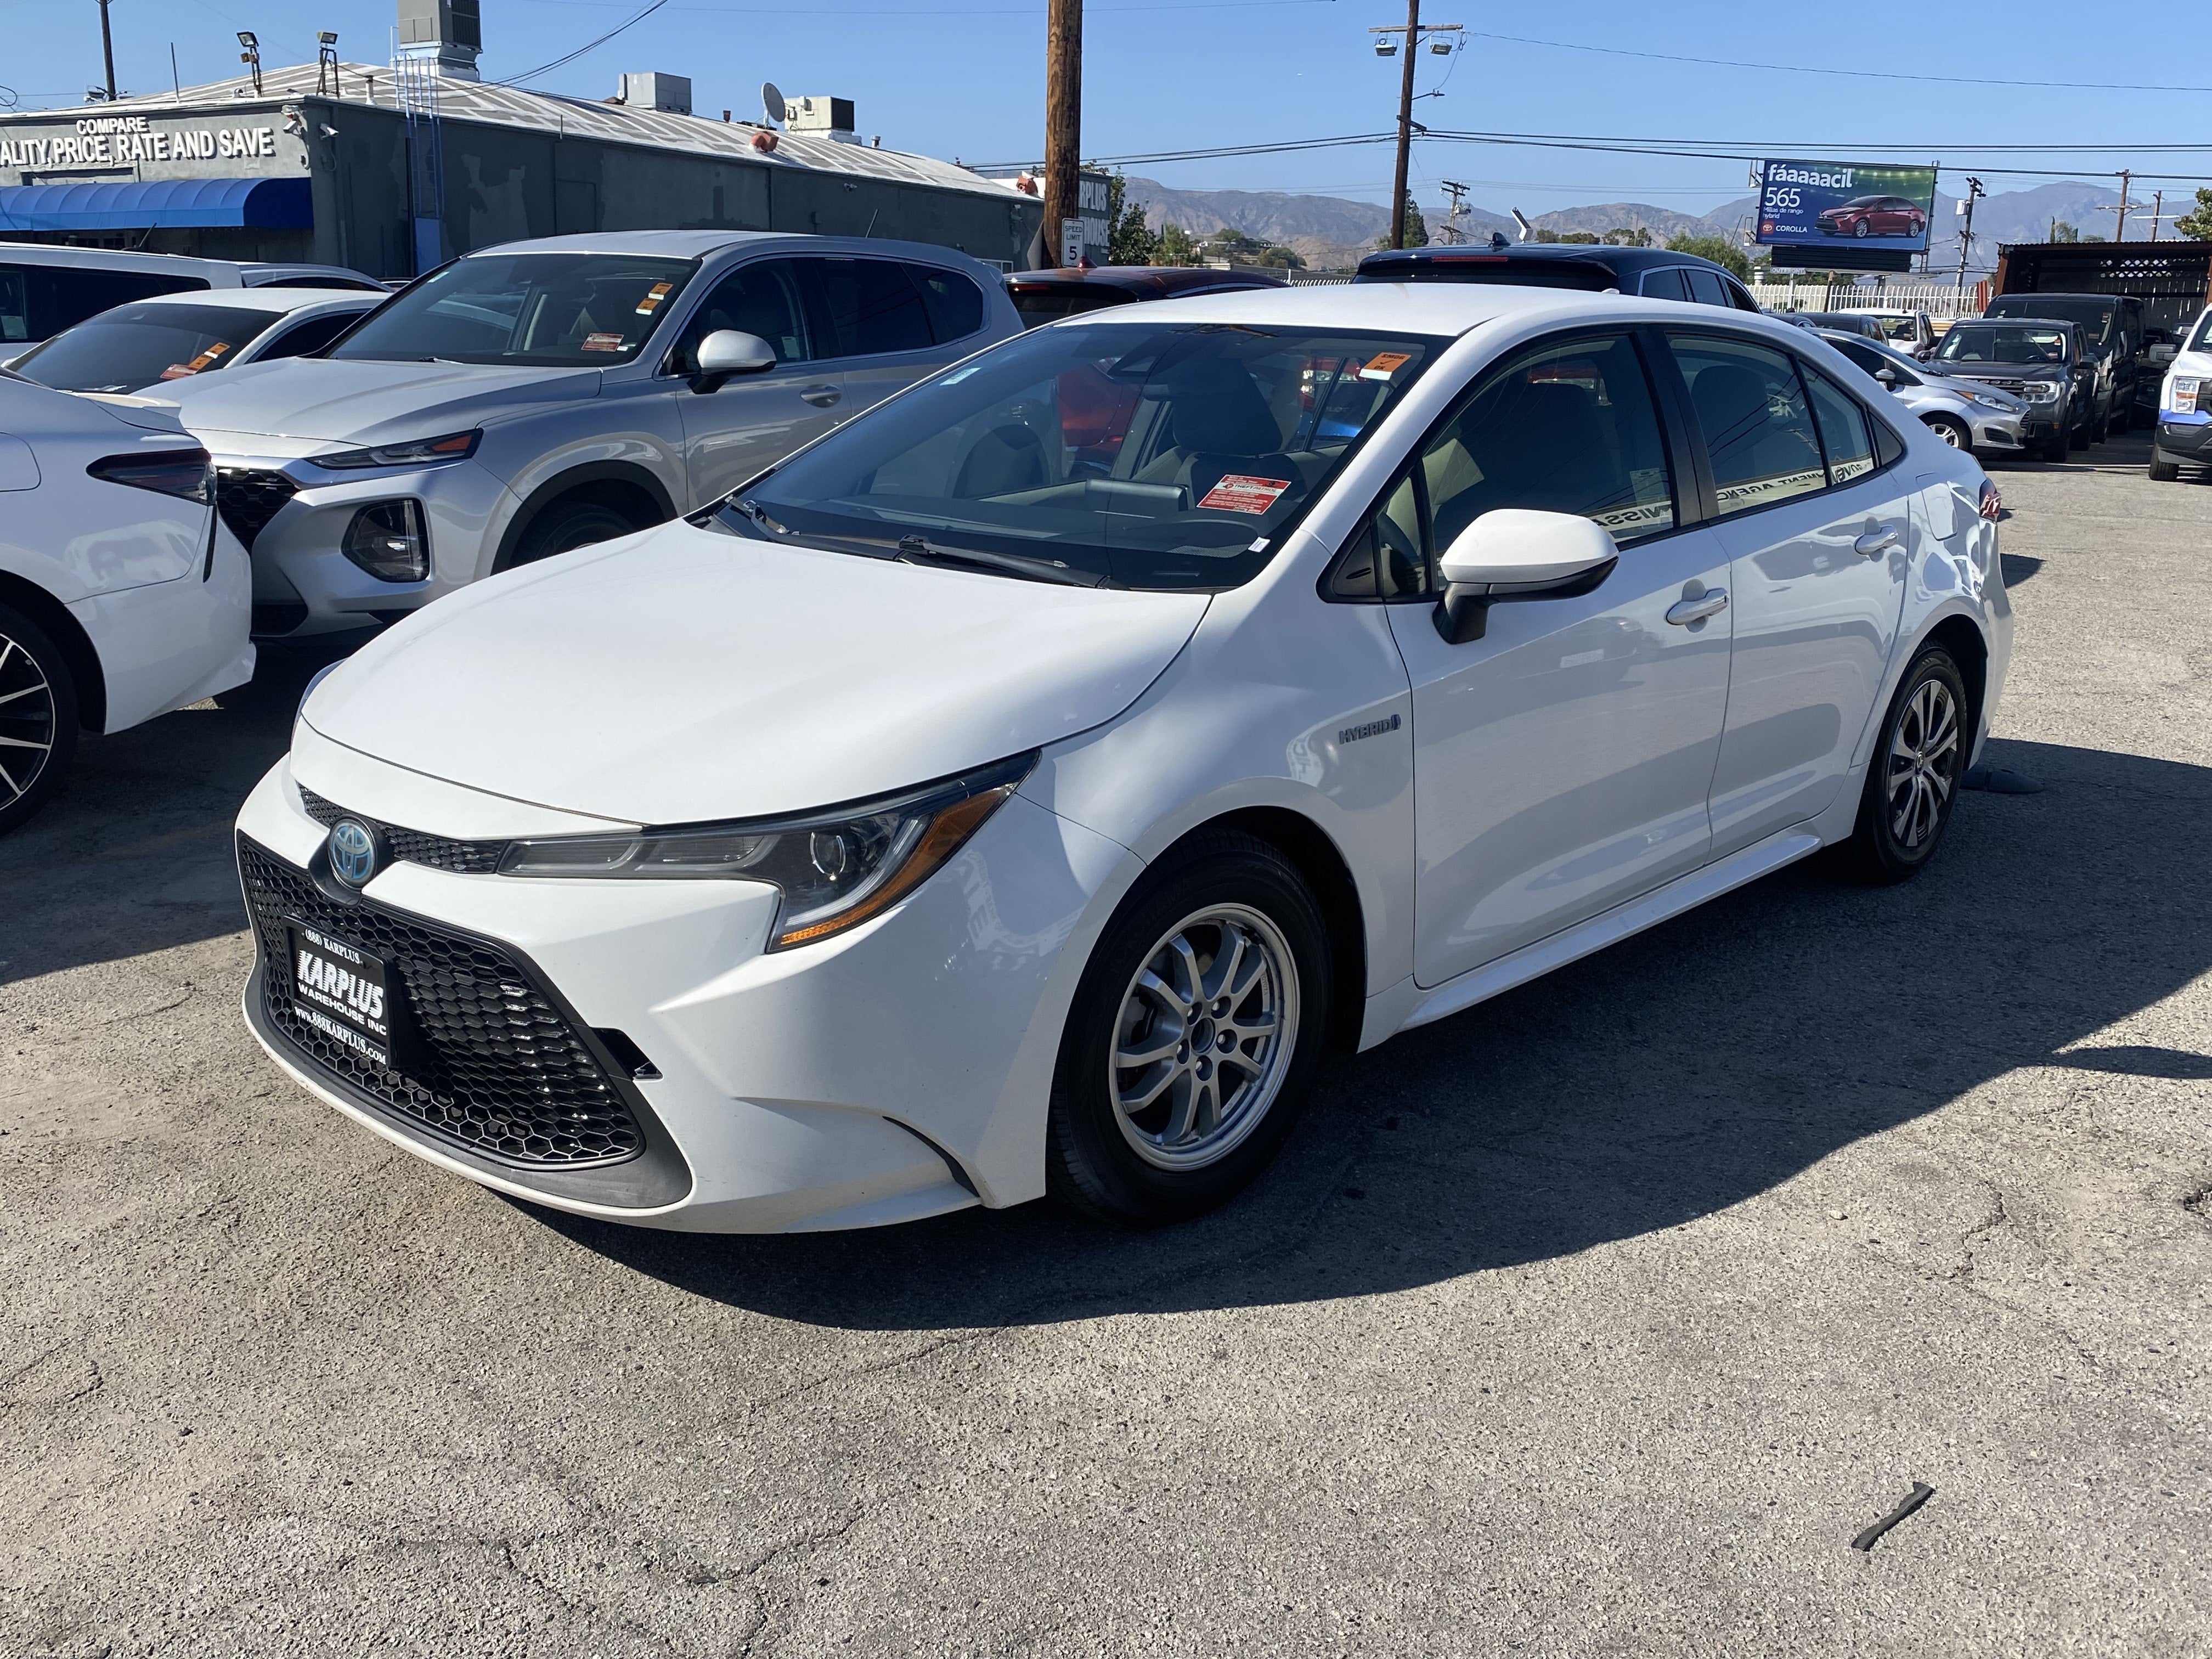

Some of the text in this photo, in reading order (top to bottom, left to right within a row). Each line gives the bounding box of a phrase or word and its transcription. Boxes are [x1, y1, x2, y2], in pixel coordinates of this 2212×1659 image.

[76, 116, 148, 134] COMPARE
[0, 127, 273, 167] ALITY, PRICE, RATE AND SAVE
[1764, 187, 1801, 207] 565
[1069, 246, 1077, 260] 5
[1339, 719, 1391, 745] HYBRID
[305, 929, 360, 964] (888) KARPLUS
[297, 950, 383, 1019] KARPLUS
[298, 982, 387, 1036] WAREHOUSE INC
